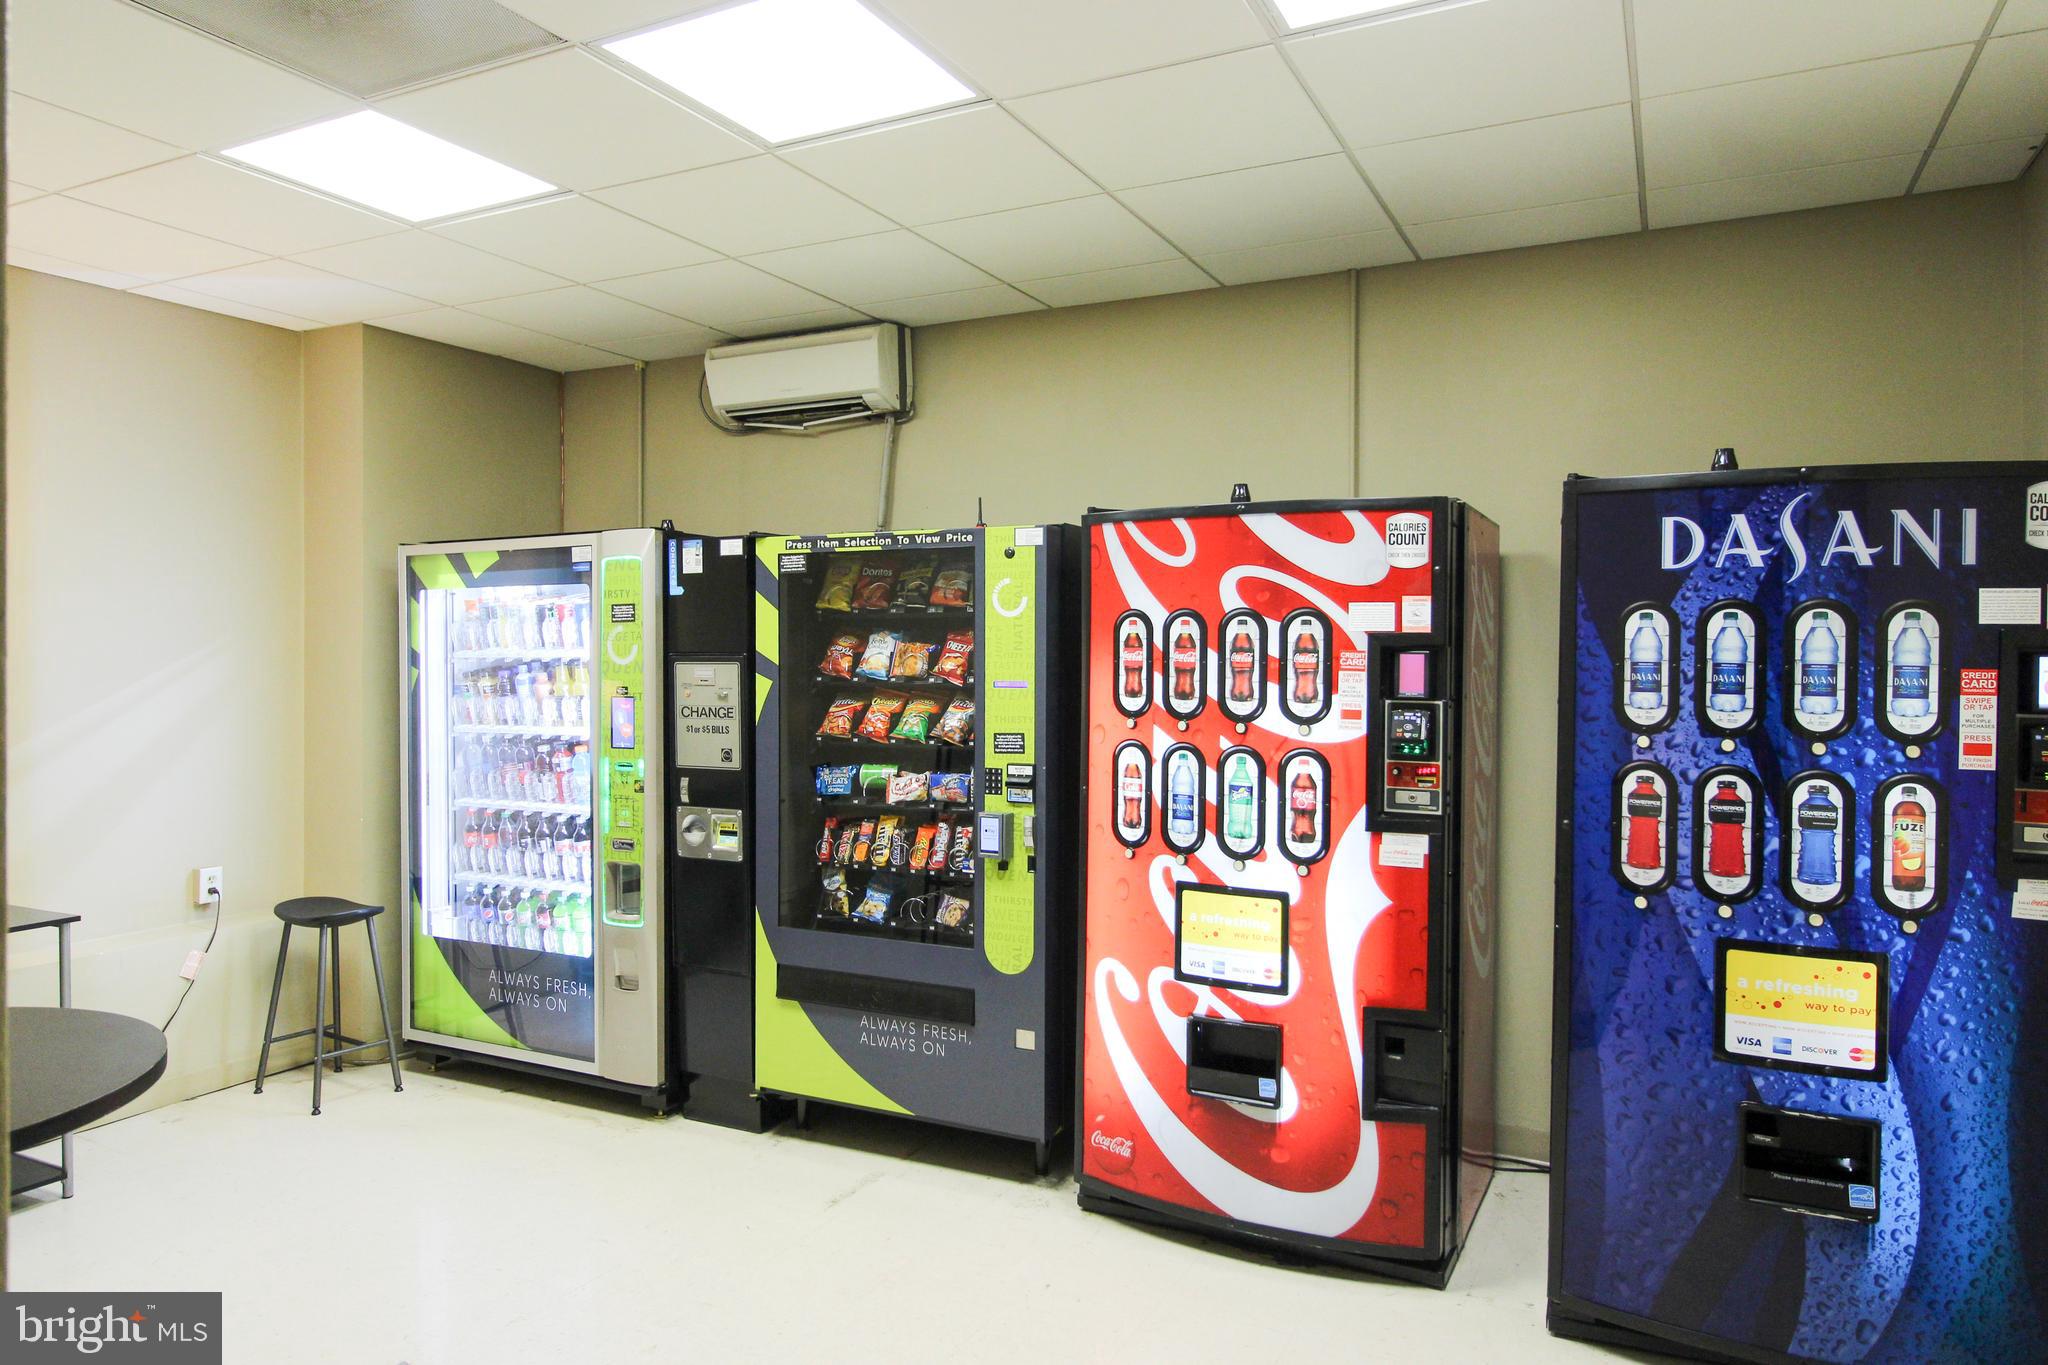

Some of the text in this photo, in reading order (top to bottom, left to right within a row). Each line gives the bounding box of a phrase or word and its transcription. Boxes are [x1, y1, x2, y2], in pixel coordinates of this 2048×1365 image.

[1388, 523, 1427, 532] CALORIES
[786, 533, 974, 549] Press Item Selection To View Price
[1388, 533, 1427, 546] COUNT
[1661, 491, 1978, 584] DASANI
[862, 567, 893, 577] Doritos
[1631, 672, 1661, 681] DASANI
[1713, 674, 1745, 683] DASANI
[1803, 675, 1836, 685] DASANI
[1894, 677, 1928, 686] DASANI
[1961, 680, 1997, 688] CARD
[681, 705, 734, 719] CHANGE
[686, 725, 694, 733] $1
[702, 725, 711, 734] $5
[712, 726, 730, 735] BILLS
[1894, 823, 1924, 832] FUZE
[1189, 960, 1206, 968] VISA
[488, 969, 592, 1000] ALWAYS FRESH,
[1737, 978, 1859, 1003] a refreshing
[488, 987, 568, 1013] ALWAYS ON
[1805, 1002, 1872, 1016] way to pay
[860, 1015, 972, 1045] ALWAYS FRESH,
[860, 1032, 945, 1057] ALWAYS ON
[1737, 1036, 1762, 1047] VISA
[1802, 1045, 1838, 1055] DISCOVER
[1091, 1129, 1134, 1158] Coca-Cola
